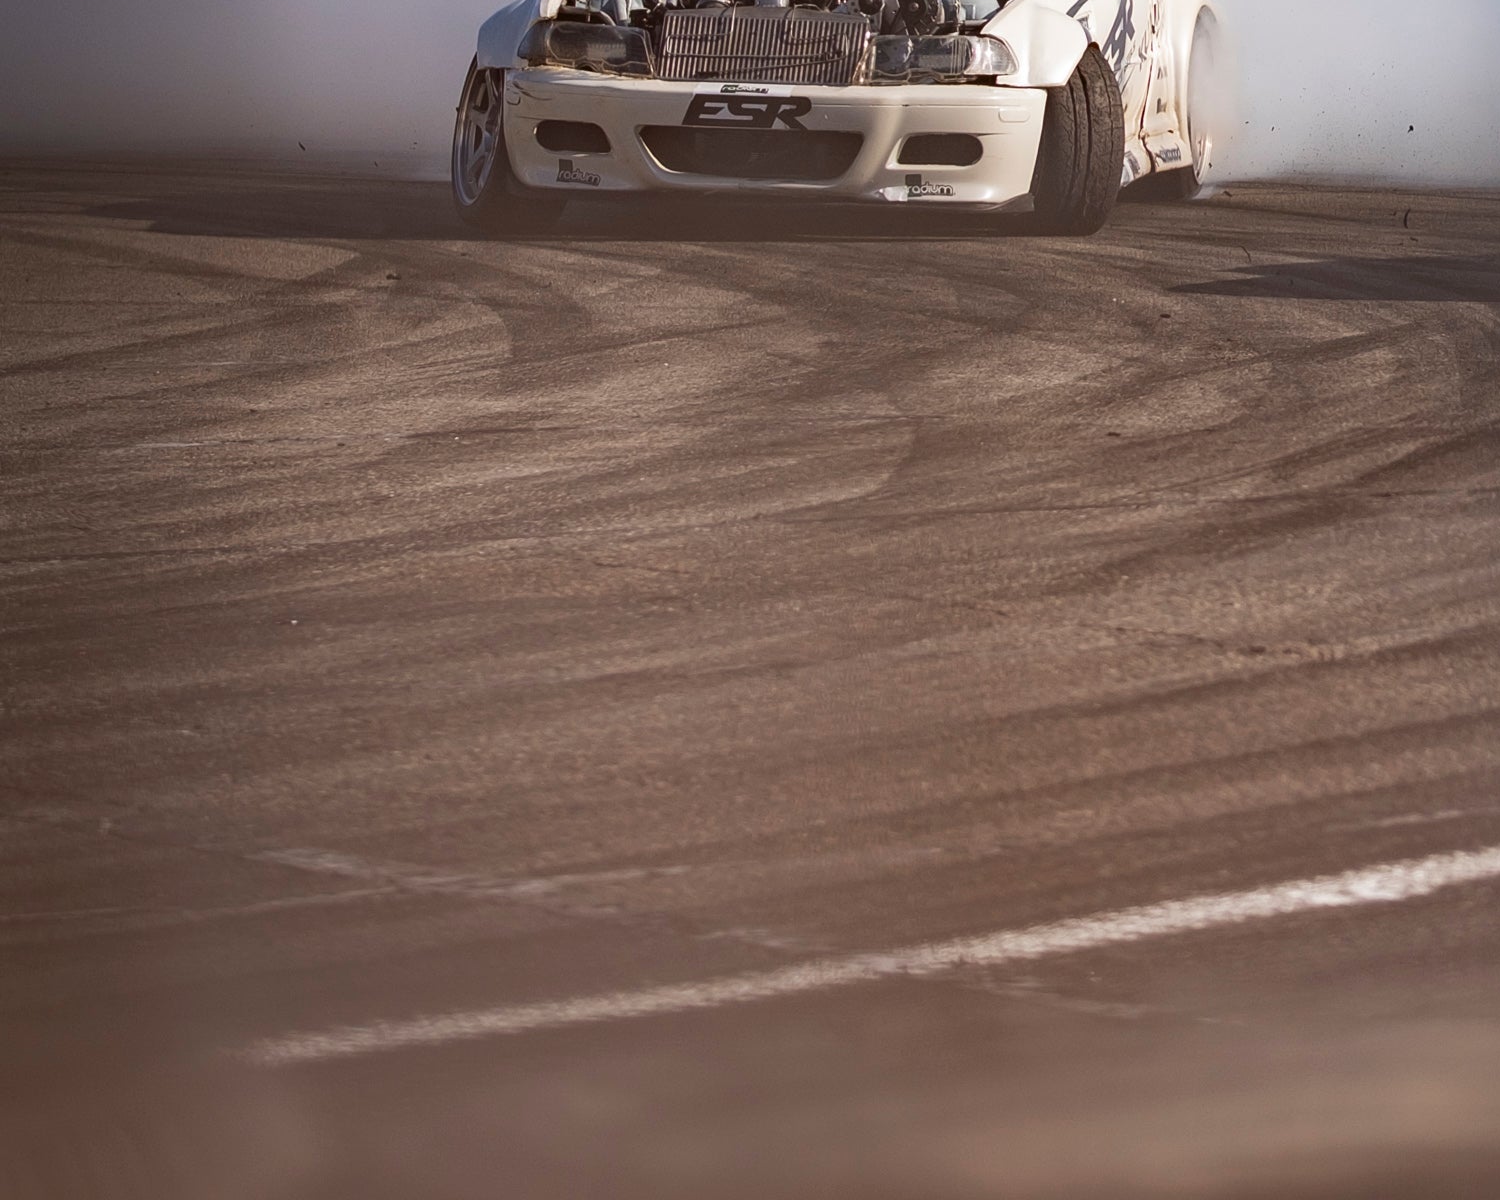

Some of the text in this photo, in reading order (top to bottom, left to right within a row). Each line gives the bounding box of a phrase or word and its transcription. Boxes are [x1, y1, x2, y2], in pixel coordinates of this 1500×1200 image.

[682, 94, 813, 131] ESR
[558, 168, 601, 186] radium
[905, 181, 954, 196] radium
